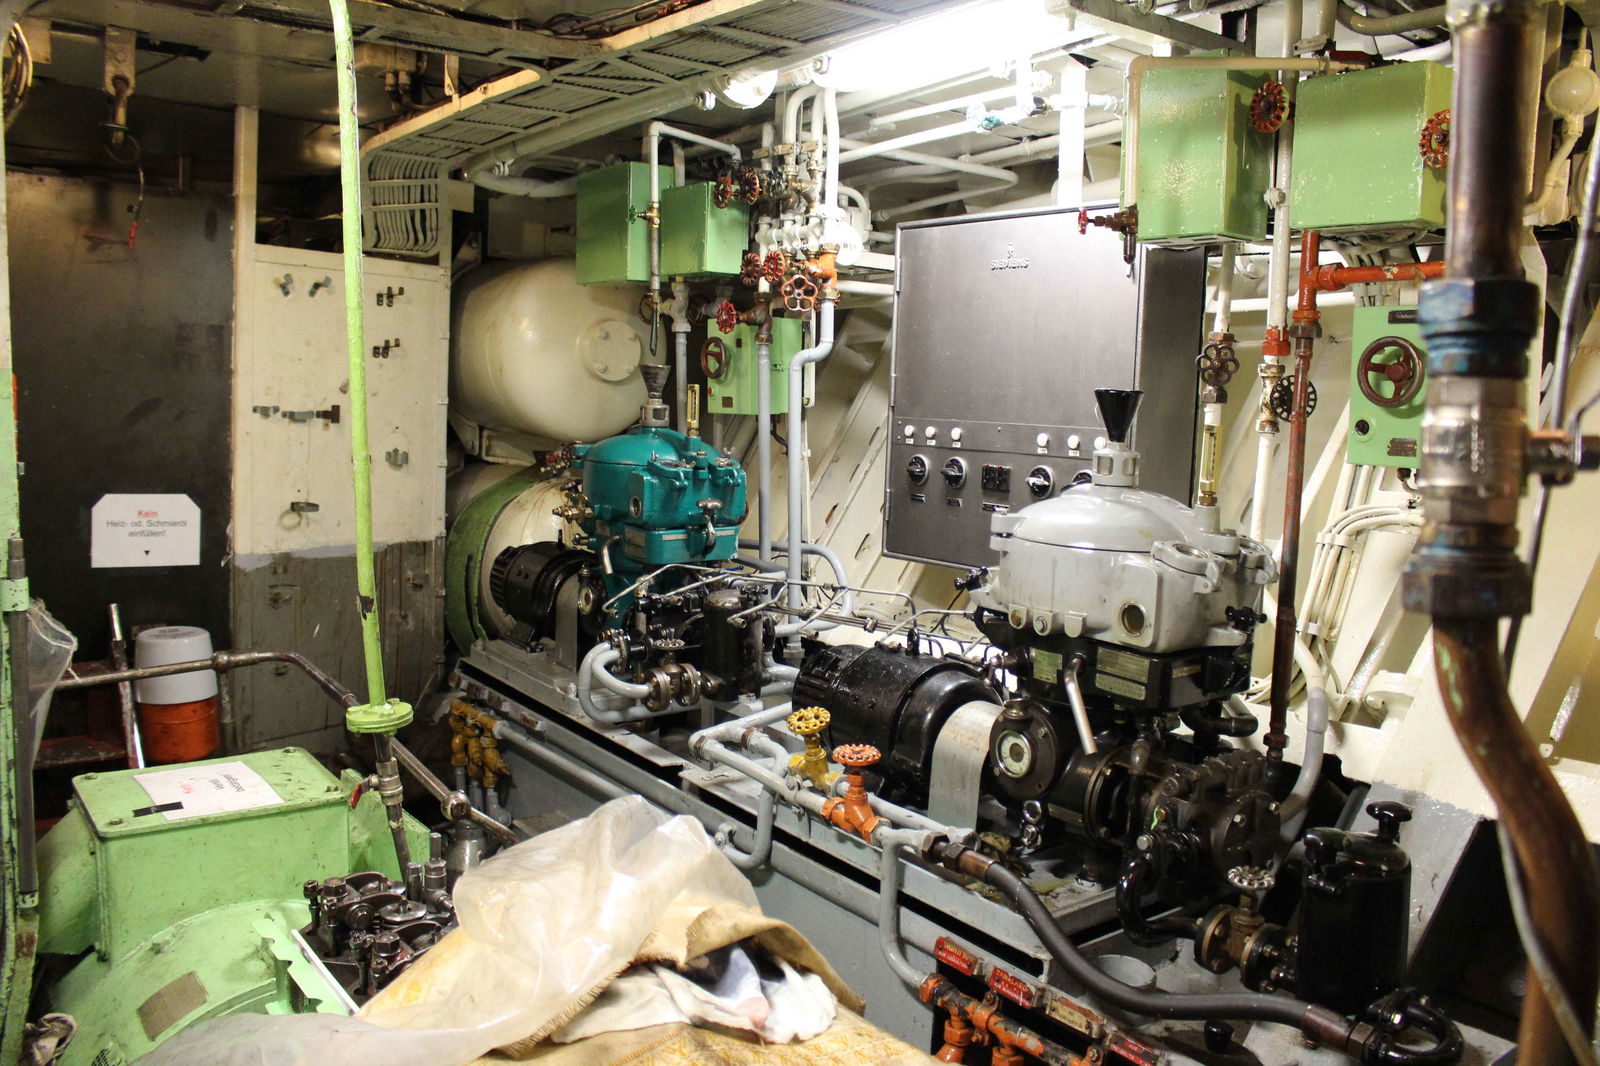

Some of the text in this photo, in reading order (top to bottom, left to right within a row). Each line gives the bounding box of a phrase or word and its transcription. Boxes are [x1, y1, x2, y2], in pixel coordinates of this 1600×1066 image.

[991, 258, 1029, 270] SIEMENS
[137, 510, 158, 519] Kein
[106, 519, 187, 528] Heiz- od. Schmieröl
[128, 529, 166, 538] einfüllen!
